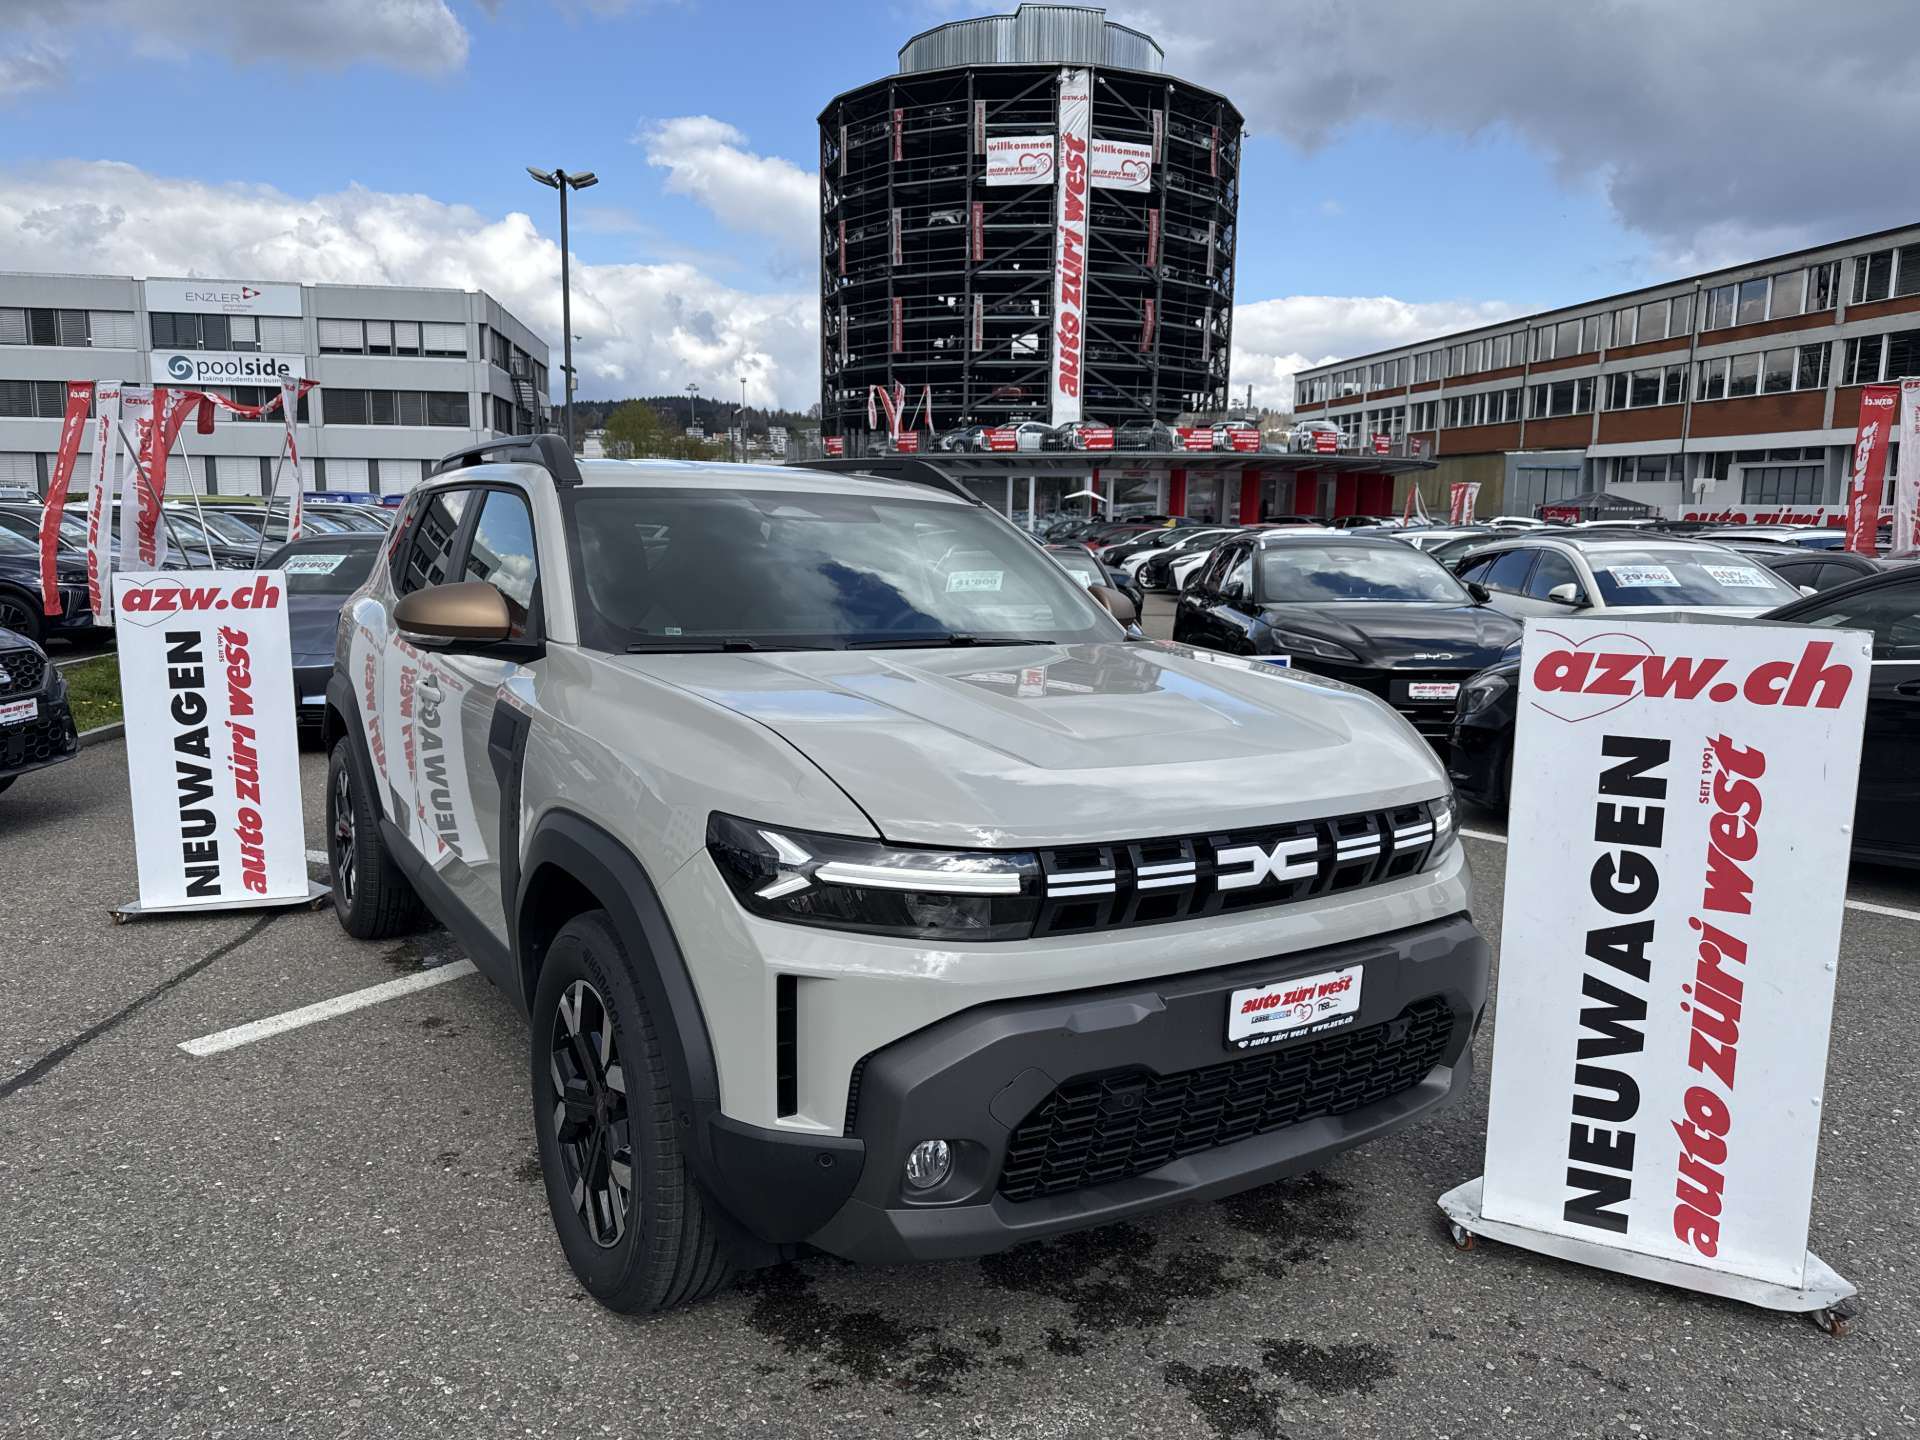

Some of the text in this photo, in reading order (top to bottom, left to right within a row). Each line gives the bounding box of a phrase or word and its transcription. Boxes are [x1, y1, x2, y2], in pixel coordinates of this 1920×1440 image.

[988, 140, 1053, 151] willkommen
[1093, 144, 1151, 158] willkommen
[1057, 131, 1087, 397] auto züri west
[185, 291, 241, 303] ENZLER
[196, 357, 290, 381] poolside
[121, 575, 280, 612] azw.ch
[1414, 652, 1454, 660] BYD
[1532, 640, 1854, 710] azw.ch
[164, 630, 222, 898] NEUWAGEN
[217, 625, 267, 895] auto züri west
[1698, 747, 1714, 805] SEIT 1991
[1241, 975, 1353, 1014] auto züri west
[1564, 734, 1672, 1236] NEUWAGEN
[1671, 732, 1767, 1260] auto züri west
[1249, 1036, 1270, 1047] auto
[1270, 1031, 1289, 1043] züri
[1289, 1027, 1309, 1038] west
